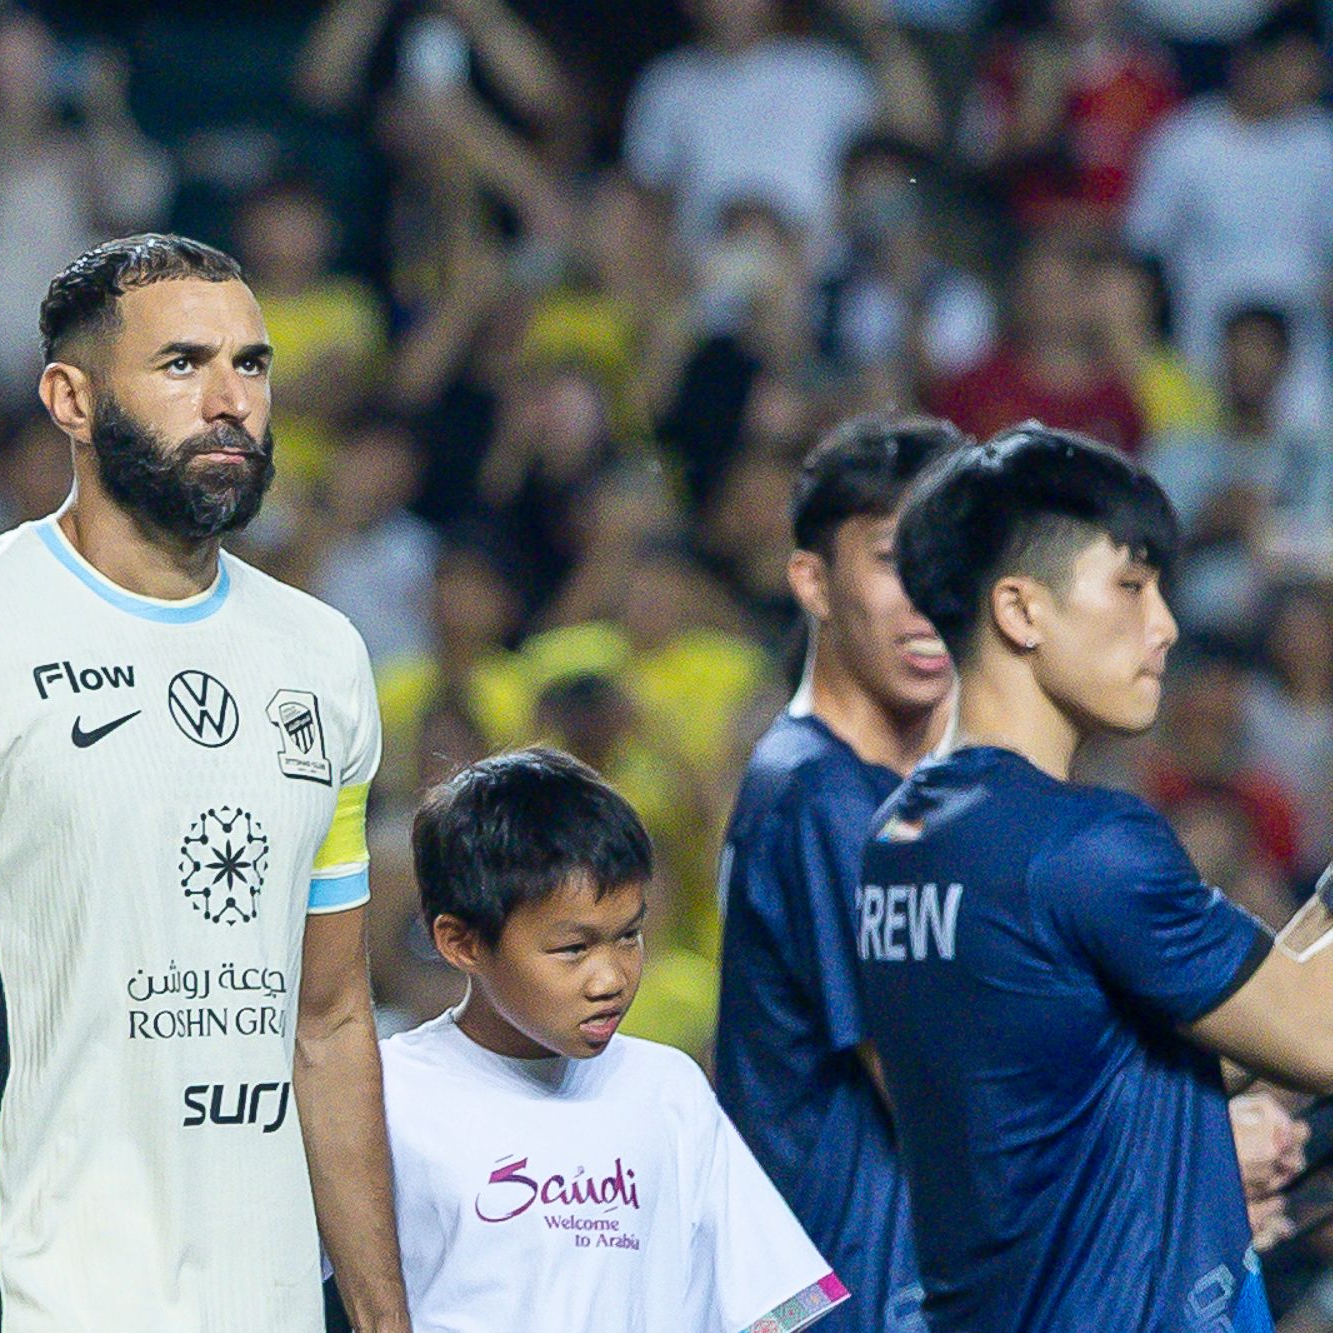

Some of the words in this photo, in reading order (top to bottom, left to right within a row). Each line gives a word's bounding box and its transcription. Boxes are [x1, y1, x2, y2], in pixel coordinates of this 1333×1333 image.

[33, 661, 135, 699] Flow
[854, 883, 964, 961] REW
[127, 959, 210, 1002] روشن
[129, 1007, 228, 1039] ROSHN
[183, 1082, 291, 1133] surj
[475, 1155, 641, 1223] Saudi
[544, 1215, 620, 1232] Welcome
[575, 1233, 591, 1248] to
